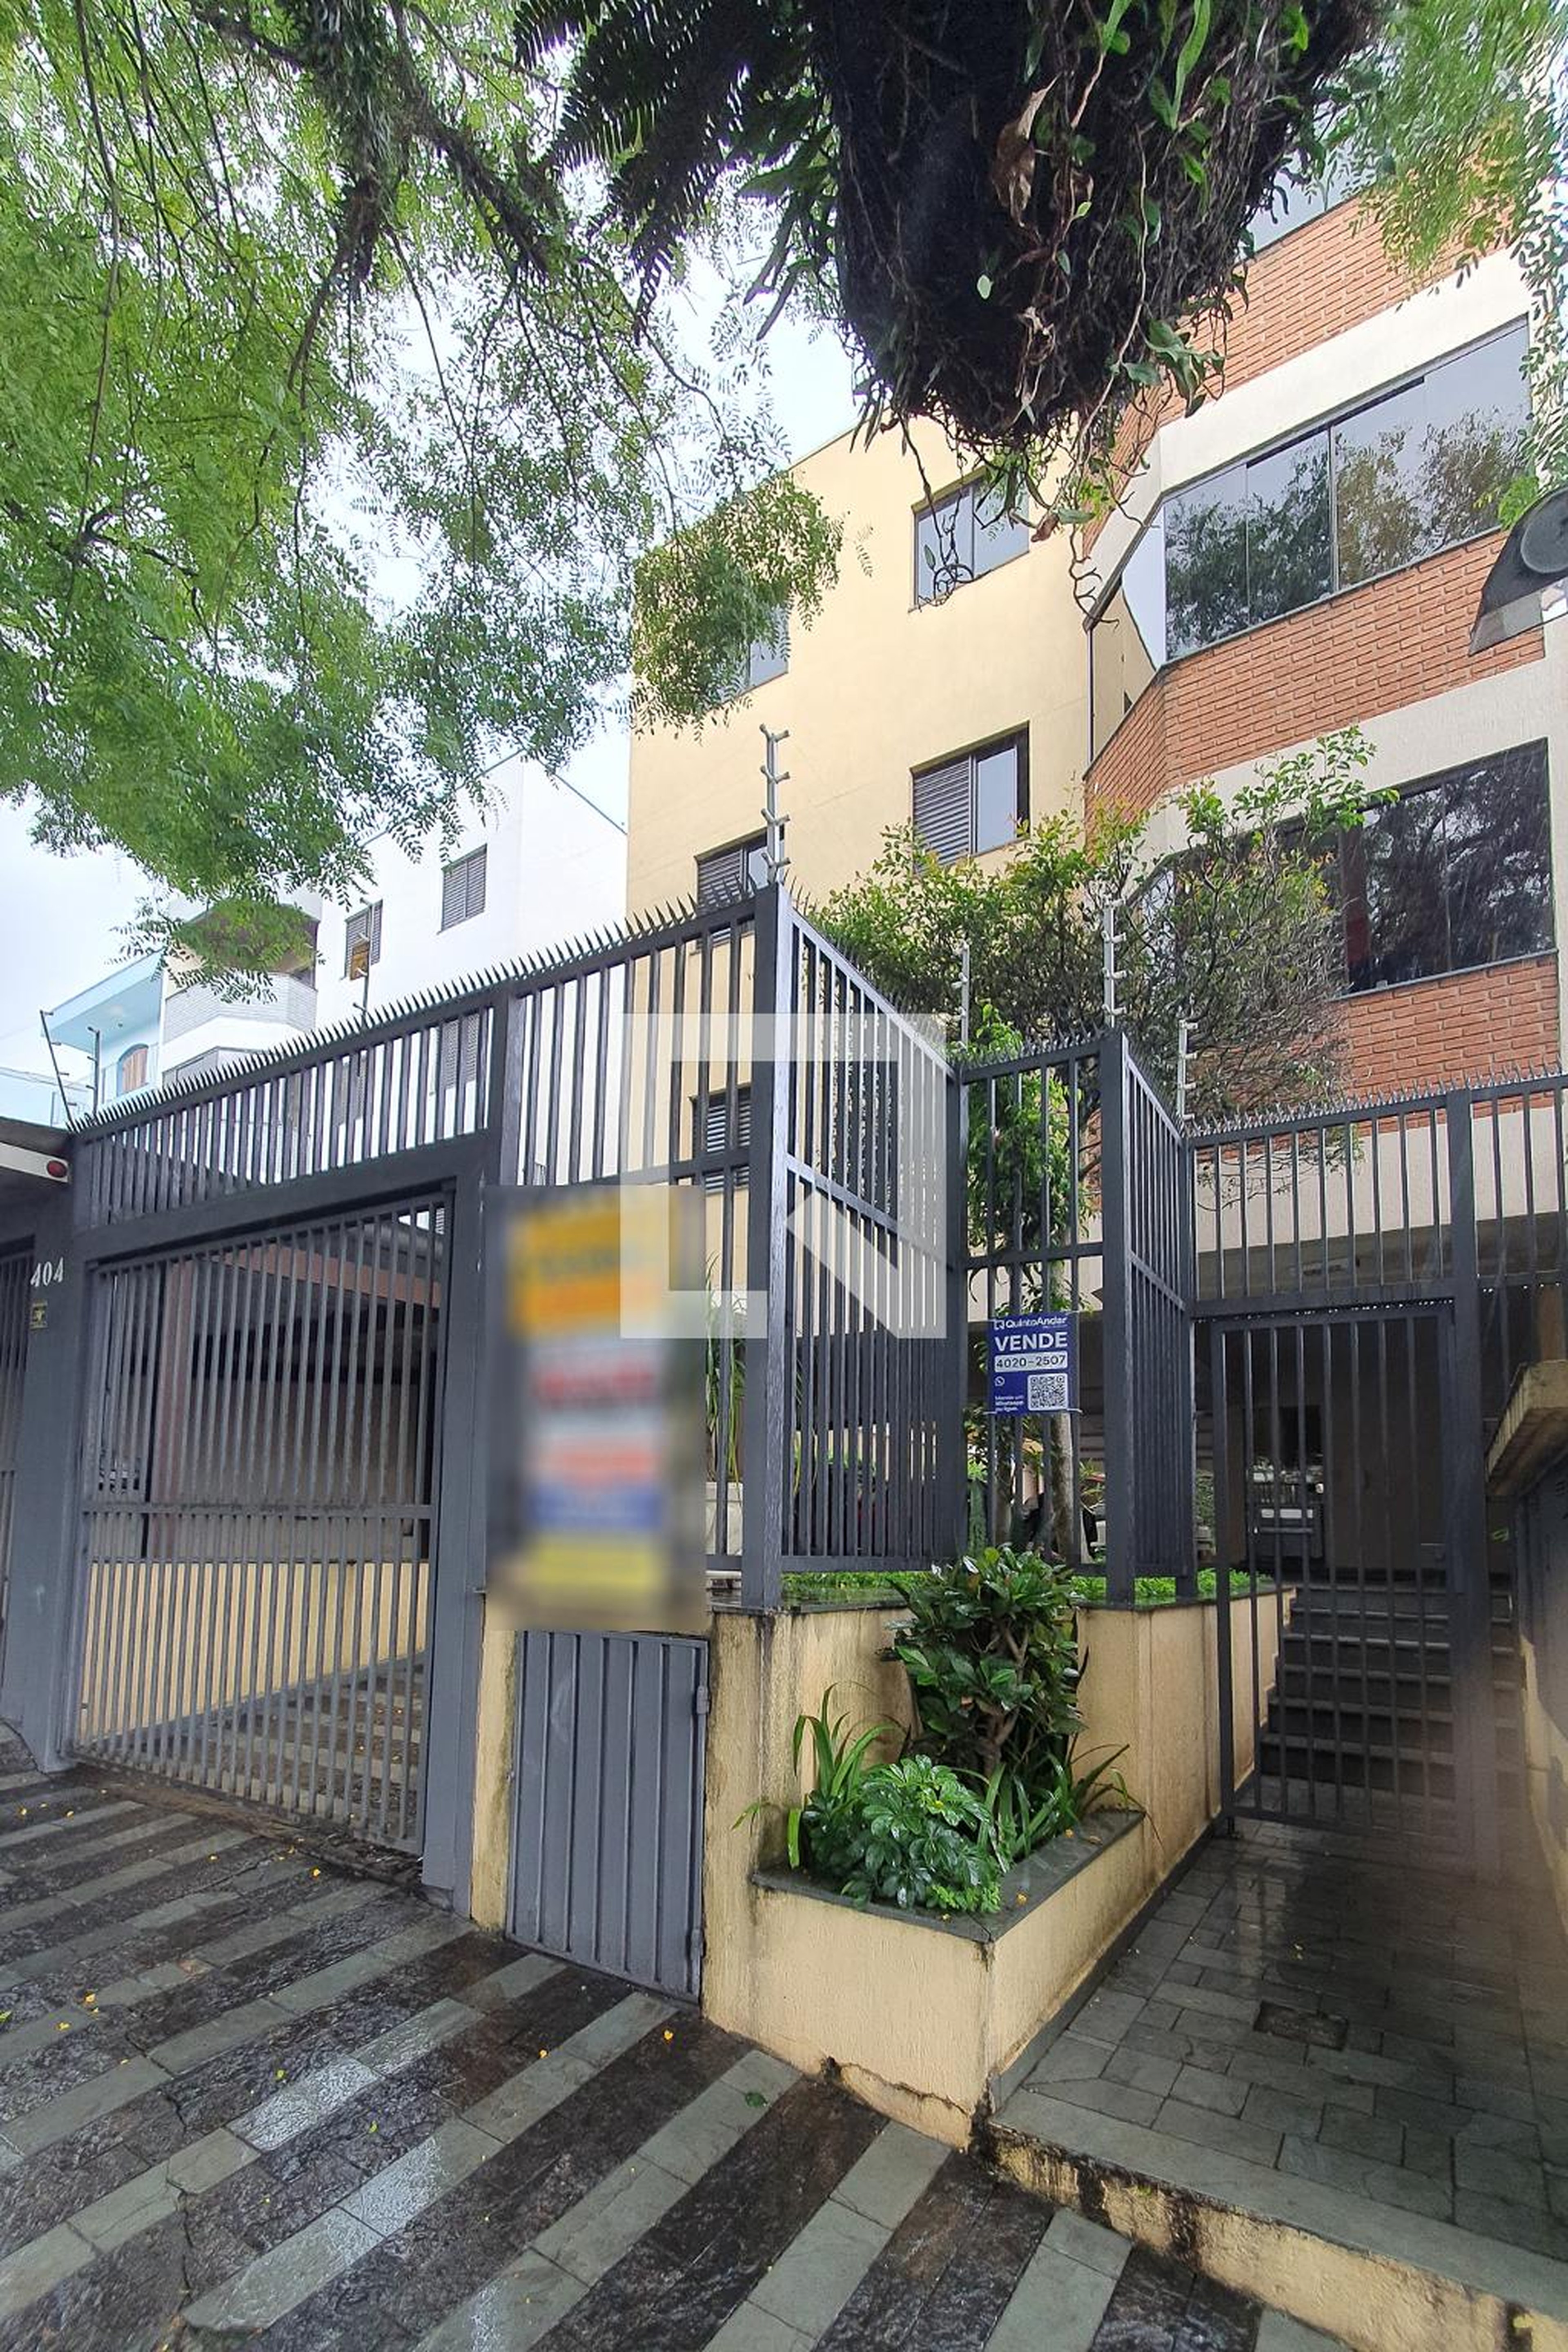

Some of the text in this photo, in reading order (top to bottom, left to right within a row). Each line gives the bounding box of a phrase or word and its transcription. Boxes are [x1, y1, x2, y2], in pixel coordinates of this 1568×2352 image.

[30, 1256, 63, 1287] 404
[995, 1332, 1068, 1351] VENDE
[996, 1355, 1065, 1368] 4020-2507
